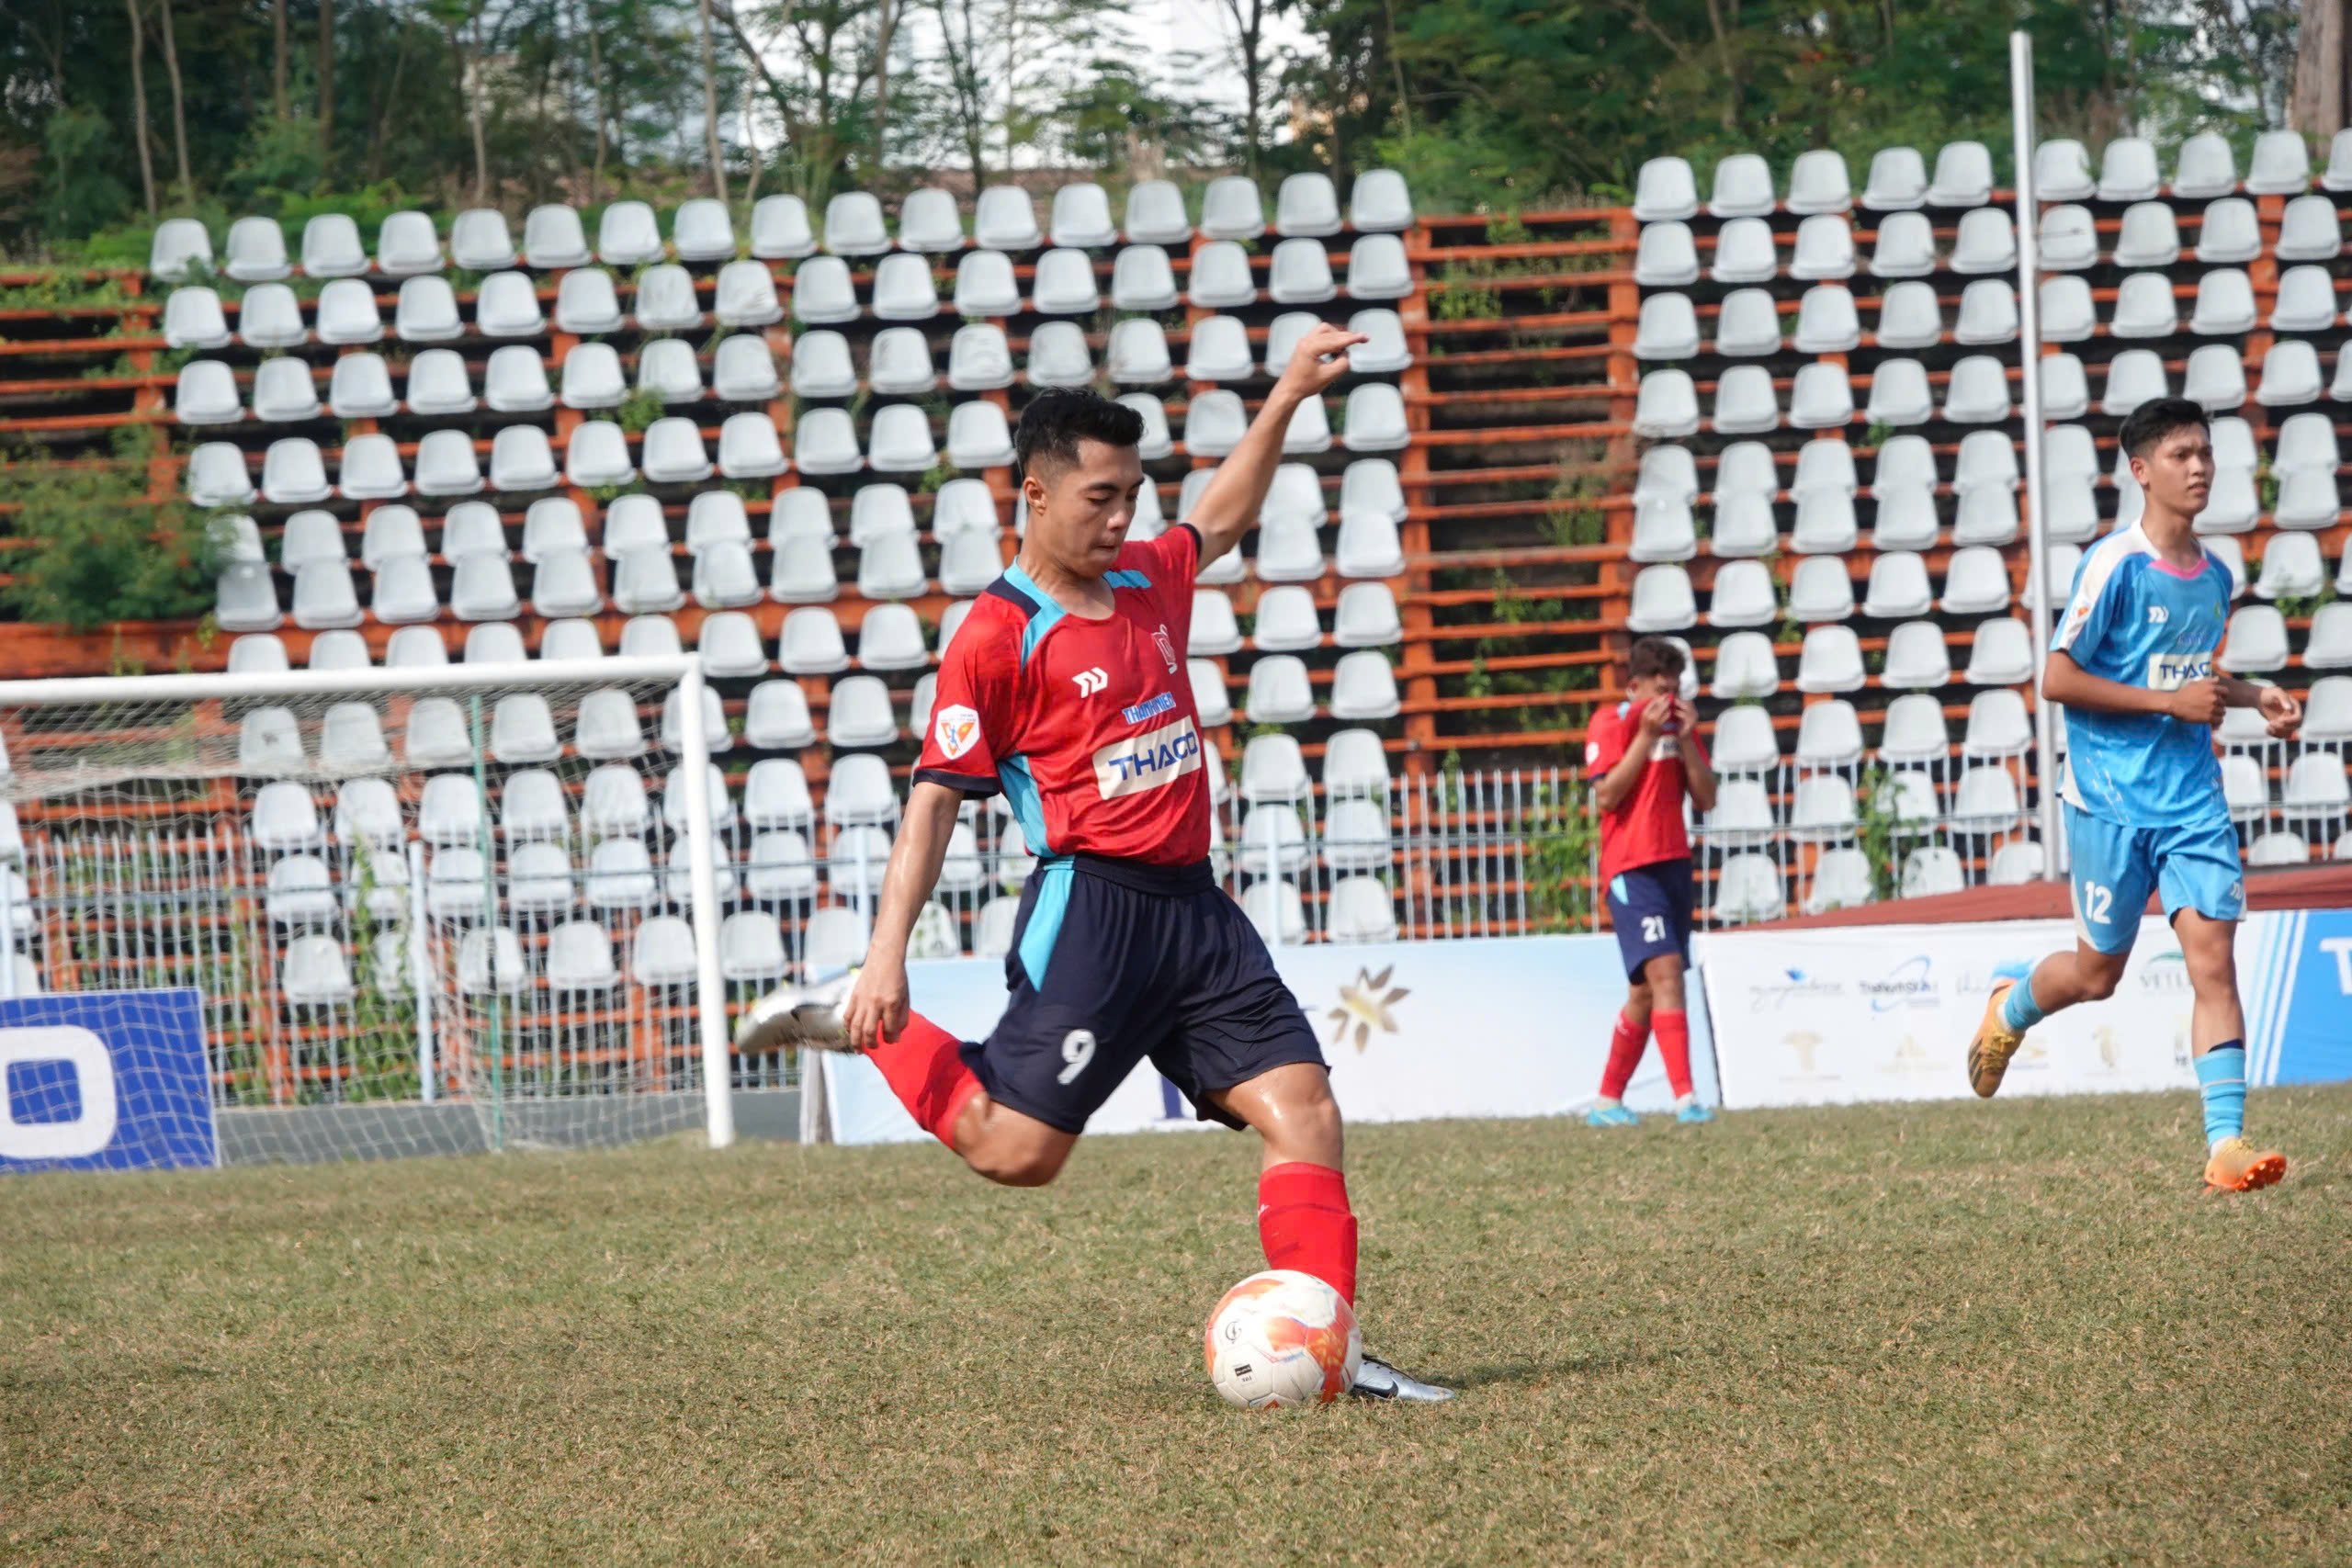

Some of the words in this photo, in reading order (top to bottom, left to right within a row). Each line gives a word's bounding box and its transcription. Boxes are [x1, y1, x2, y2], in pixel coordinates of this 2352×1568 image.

[1109, 731, 1198, 781] THACO
[2085, 881, 2113, 924] 12
[1640, 916, 1666, 943] 21
[1058, 1028, 1098, 1086] 9
